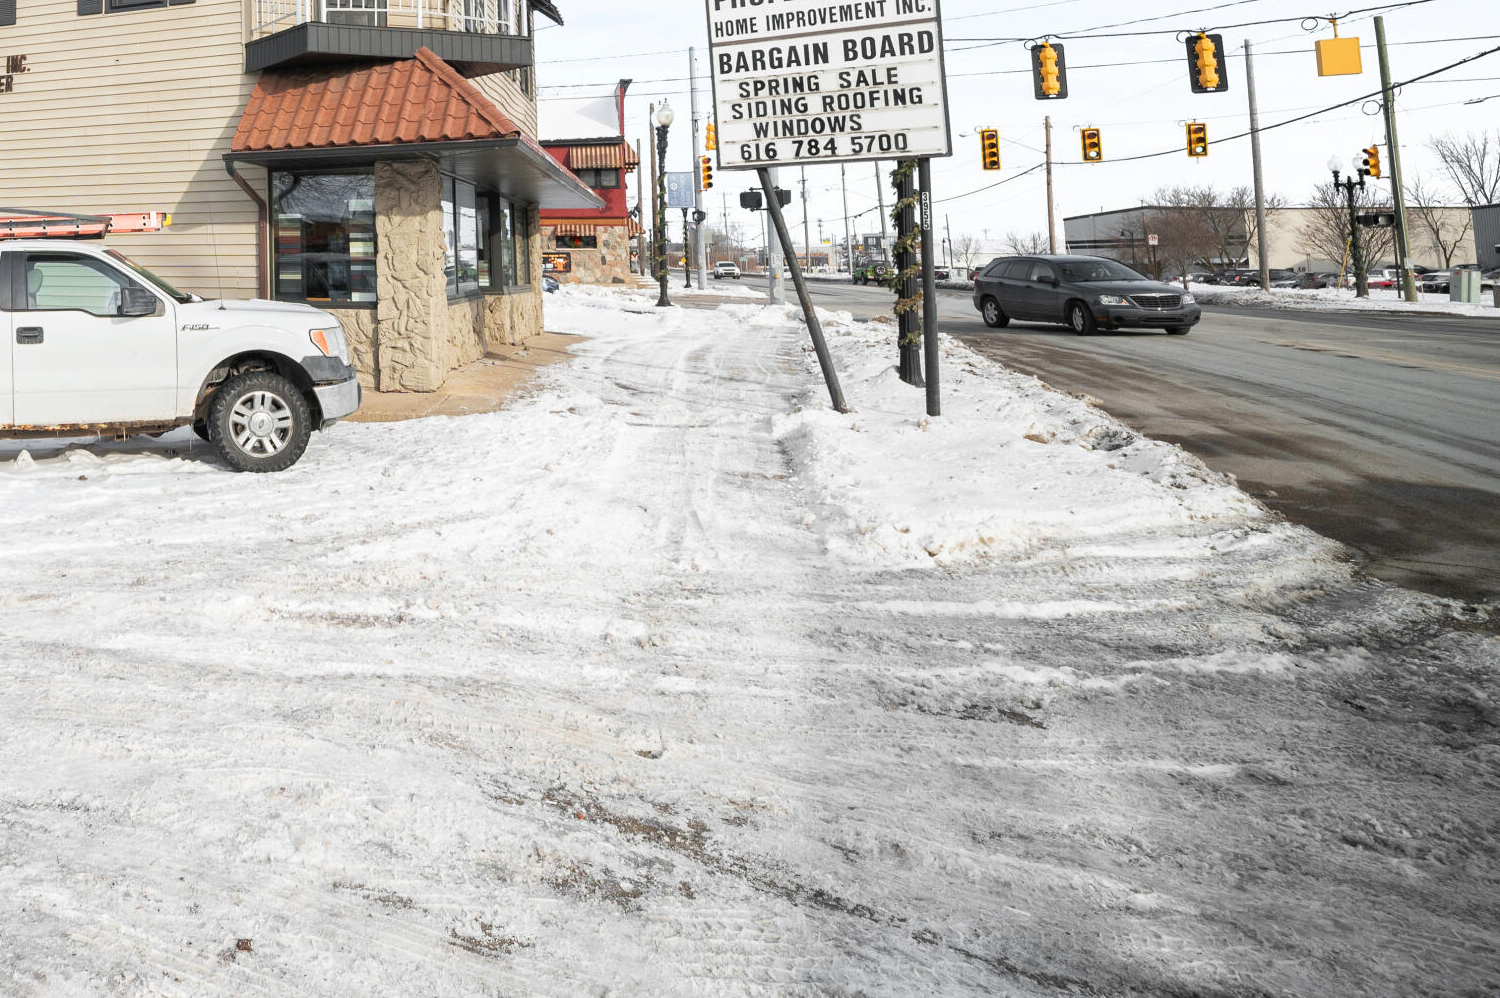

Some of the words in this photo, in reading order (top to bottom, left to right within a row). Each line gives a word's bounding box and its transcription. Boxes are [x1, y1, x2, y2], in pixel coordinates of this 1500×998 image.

[714, 16, 758, 38] HOME
[766, 0, 887, 31] IMPROVEMENT
[6, 54, 31, 74] INC.
[718, 41, 830, 75] BARGAIN
[842, 30, 935, 62] BOARD
[738, 75, 820, 98] SPRING
[838, 67, 899, 89] SALE
[731, 96, 809, 120] SIDING
[821, 87, 923, 113] ROOFING
[753, 113, 863, 139] WINDOWS
[740, 142, 778, 161] 616
[791, 137, 838, 157] 784
[851, 132, 909, 154] 5700
[922, 192, 930, 230] 3955
